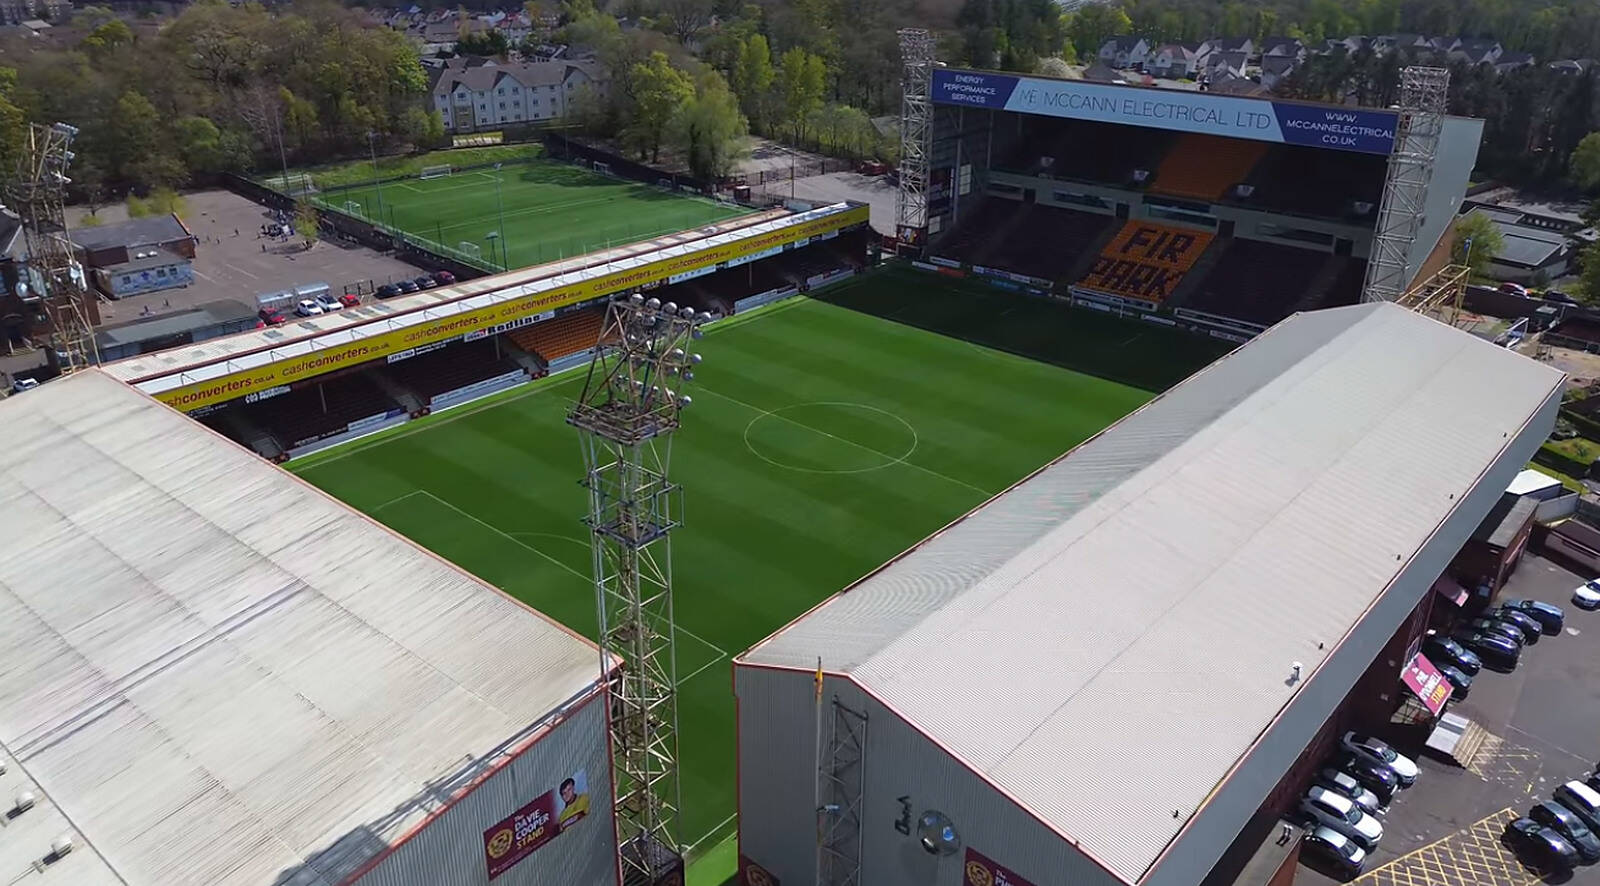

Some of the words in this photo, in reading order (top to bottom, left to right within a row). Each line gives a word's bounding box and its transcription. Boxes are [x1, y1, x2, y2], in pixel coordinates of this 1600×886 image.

[943, 82, 997, 96] PERFORMANCE
[954, 75, 985, 84] ENERGY
[951, 93, 986, 104] SERVICES
[1043, 91, 1117, 113] MCCANN
[1122, 99, 1229, 126] ELECTRICAL
[1236, 111, 1271, 130] LTD
[1120, 227, 1196, 263] FIR
[1076, 257, 1184, 298] PARK
[514, 808, 540, 832] DAVIE
[515, 813, 549, 840] COOPER
[516, 826, 545, 850] STAND
